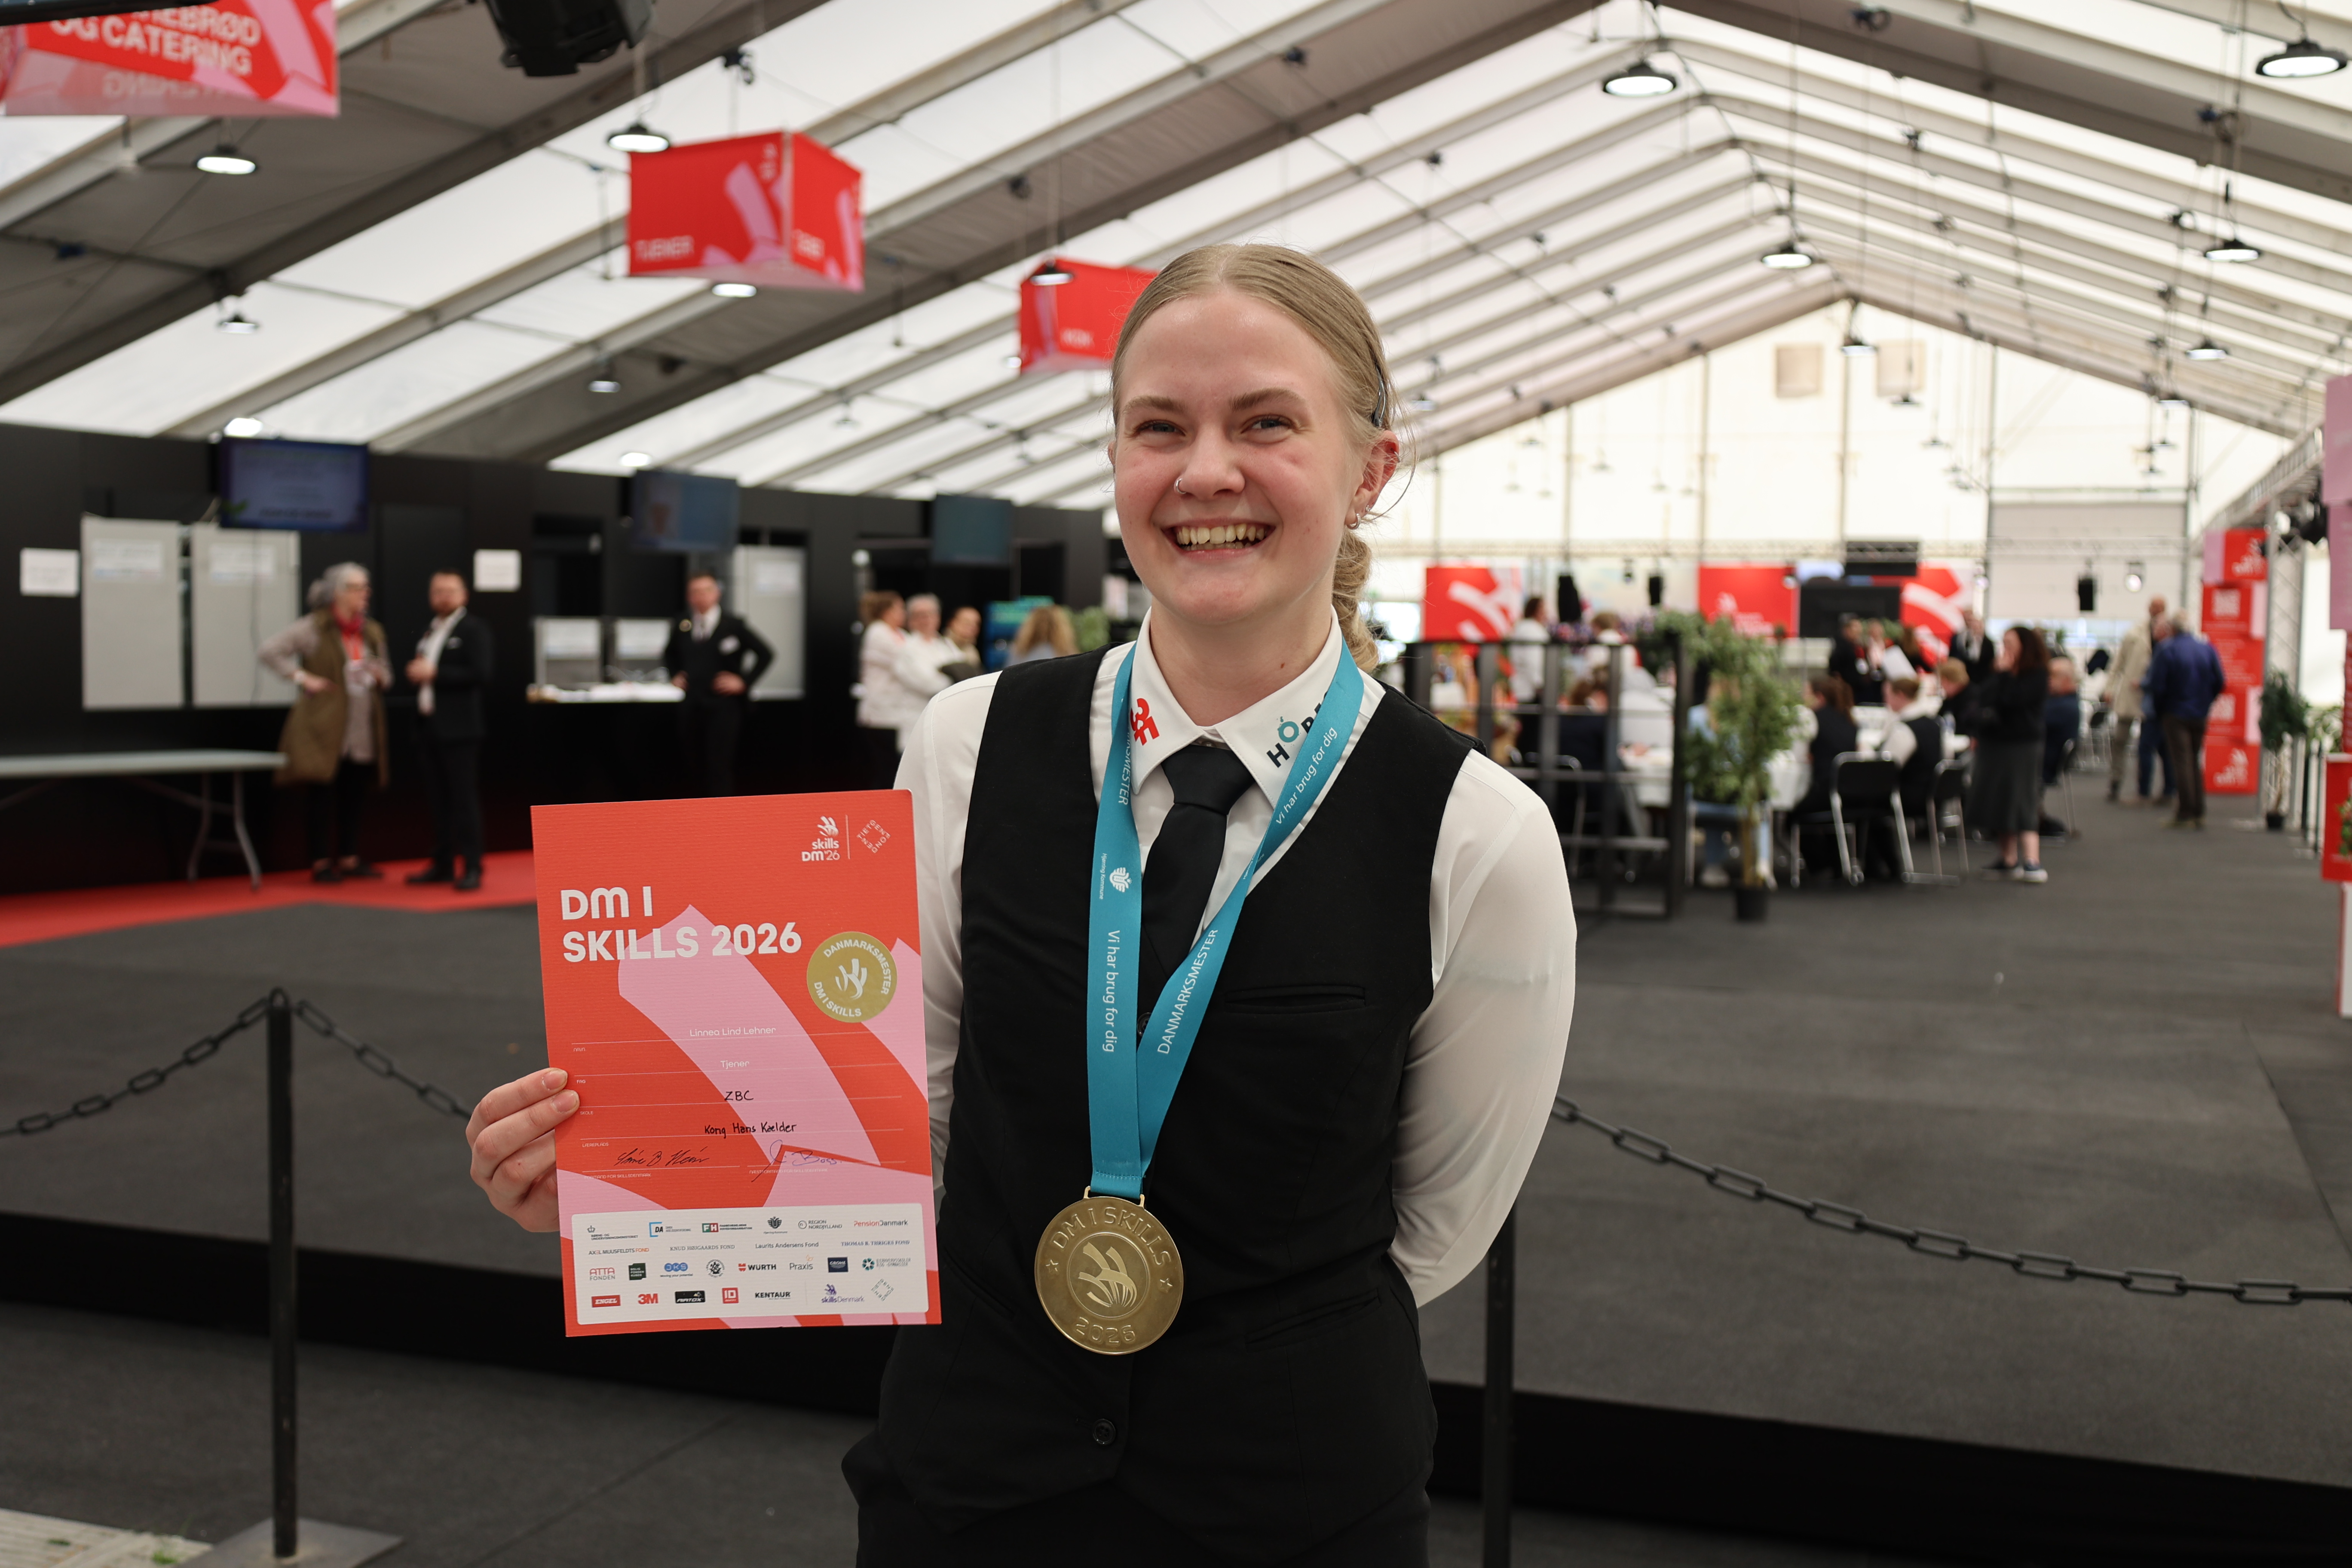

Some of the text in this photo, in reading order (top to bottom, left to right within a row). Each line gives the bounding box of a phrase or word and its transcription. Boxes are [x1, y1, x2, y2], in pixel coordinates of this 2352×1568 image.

[101, 15, 252, 76] CATERING
[1283, 792, 1298, 813] har
[1295, 765, 1317, 793] brug
[1312, 747, 1325, 765] for
[1323, 727, 1338, 747] dig
[812, 838, 839, 849] skills
[560, 886, 652, 920] DM I
[563, 922, 802, 962] SKILLS 2026
[823, 939, 891, 995] DANMARKSMESTER
[814, 981, 826, 999] DM
[826, 1001, 862, 1017] SKILLS
[1102, 930, 1120, 1052] Vi har brug for dig
[1157, 929, 1218, 1054] DANMARKSMESTER
[743, 1027, 776, 1035] Lehner
[720, 1060, 750, 1069] Tjener
[724, 1090, 754, 1101] ZBC
[704, 1124, 726, 1139] Kong
[732, 1123, 756, 1133] Hans
[1053, 1207, 1172, 1265] DM I SKILLS
[590, 1268, 615, 1276] ATTA
[638, 1293, 658, 1305] 3M
[1075, 1316, 1136, 1344] 2026
